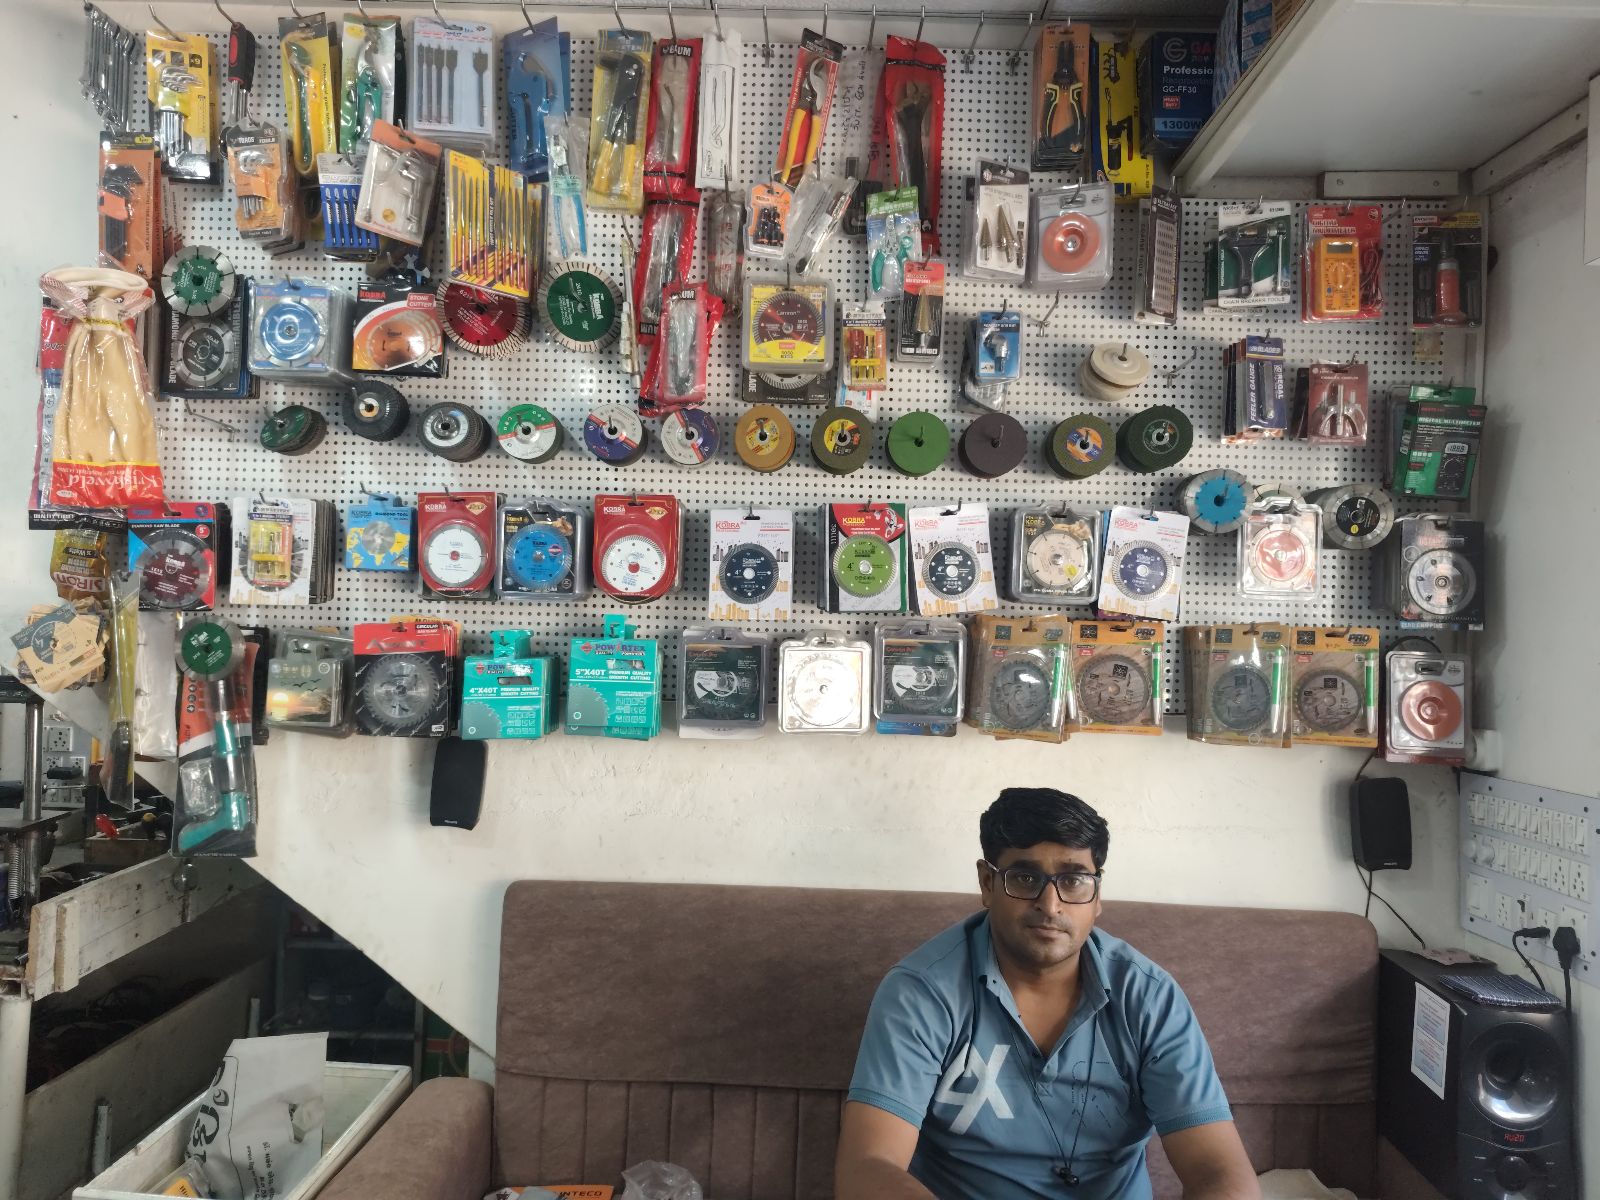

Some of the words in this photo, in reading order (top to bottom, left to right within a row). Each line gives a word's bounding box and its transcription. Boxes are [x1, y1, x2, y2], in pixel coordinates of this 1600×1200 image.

[1162, 85, 1197, 94] GC-FF30
[1161, 120, 1201, 130] 1300W
[171, 309, 180, 341] IAMOND
[749, 373, 757, 393] LADE
[715, 522, 741, 530] KOBRA
[1135, 628, 1156, 637] PRO
[1262, 631, 1282, 641] PRO
[1348, 634, 1371, 644] PRO
[575, 668, 606, 676] 5"X40T
